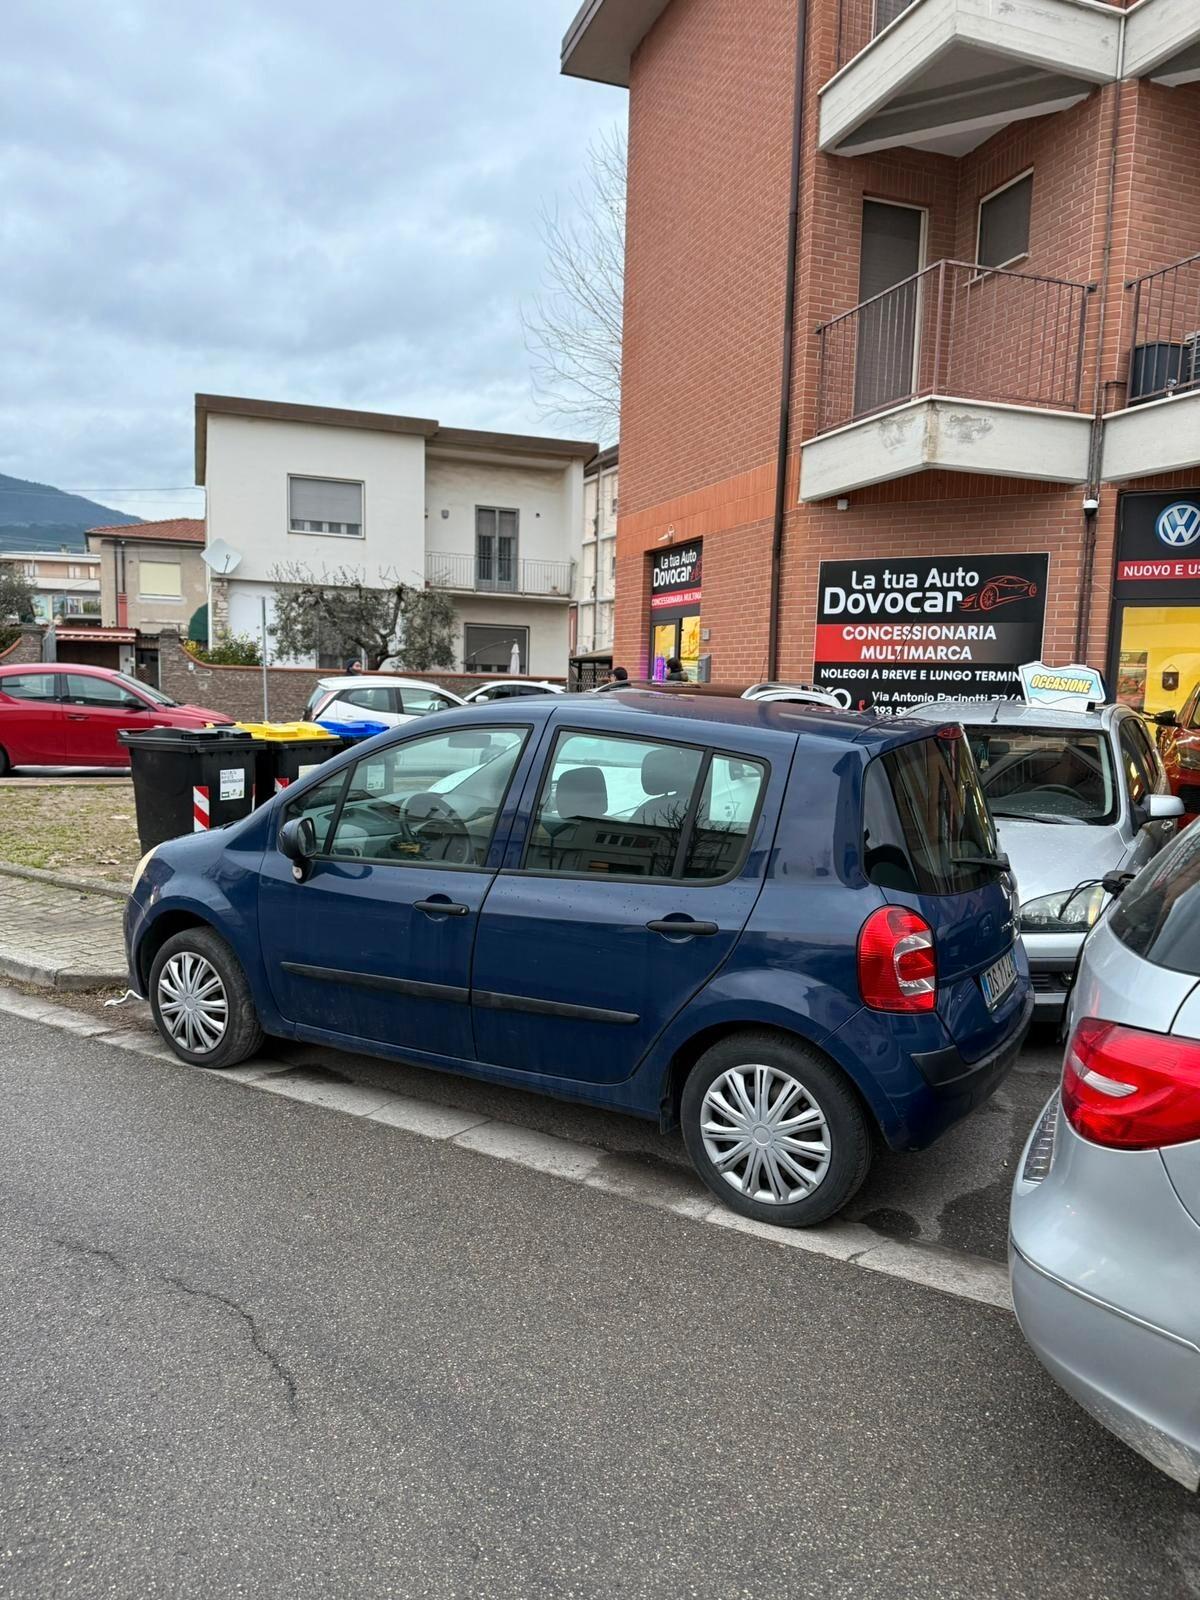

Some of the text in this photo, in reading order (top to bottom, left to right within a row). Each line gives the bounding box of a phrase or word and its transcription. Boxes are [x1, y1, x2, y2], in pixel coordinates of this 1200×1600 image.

[661, 549, 697, 569] La tua Auto
[653, 565, 692, 587] Dovocar
[851, 566, 979, 590] La tua Auto
[1123, 565, 1171, 577] NUOVO
[1175, 565, 1184, 575] E
[823, 587, 963, 614] Dovocar
[842, 625, 997, 641] CONCESSIONARIA
[860, 646, 972, 660] MULTIMARCA
[820, 668, 869, 679] NOLEGGI
[871, 669, 880, 679] A
[882, 669, 917, 680] BREVE
[919, 670, 927, 680] E
[930, 670, 972, 681] LUNGO
[1031, 674, 1093, 694] OCCASIONE
[872, 691, 889, 701] Via
[892, 691, 934, 702] Antonio
[937, 693, 988, 703] Pacinotti
